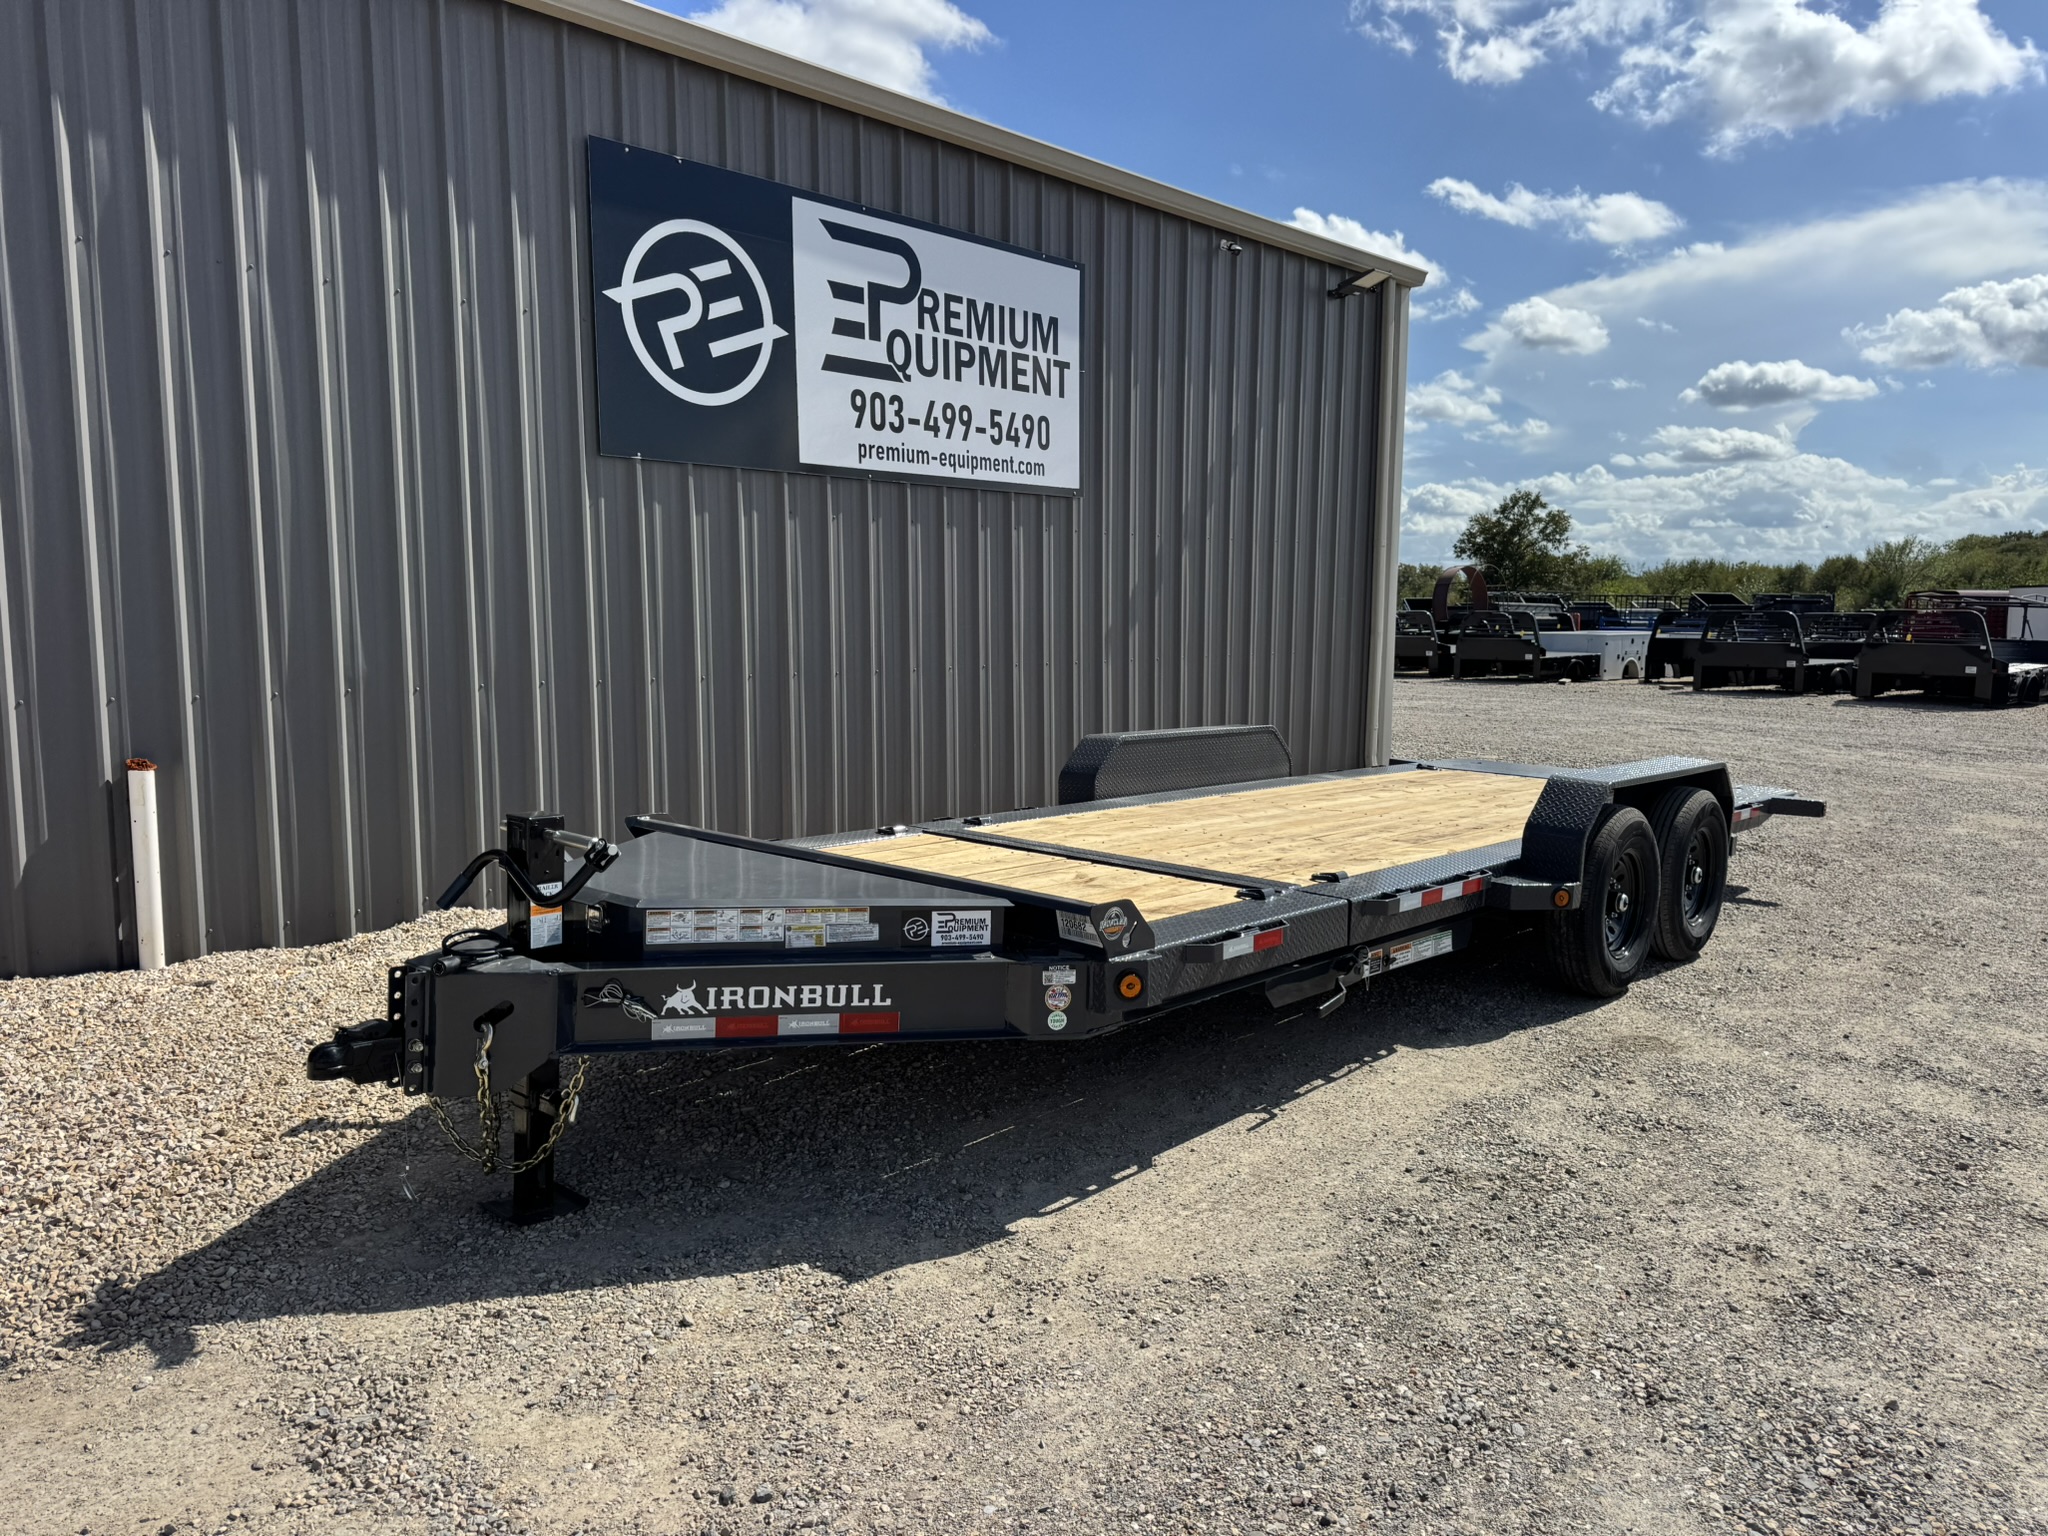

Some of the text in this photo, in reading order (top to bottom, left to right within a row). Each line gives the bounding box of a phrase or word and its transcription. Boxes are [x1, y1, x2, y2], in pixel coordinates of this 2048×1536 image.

[819, 218, 1059, 356] PREMIUM
[821, 280, 1071, 399] EQUIPMENT
[850, 389, 1051, 451] 903-499-5490
[858, 441, 1046, 478] premium-equipment.com
[936, 912, 986, 929] PREMIUM
[940, 933, 984, 941] 903-499-5490
[706, 983, 892, 1011] IRONBULL
